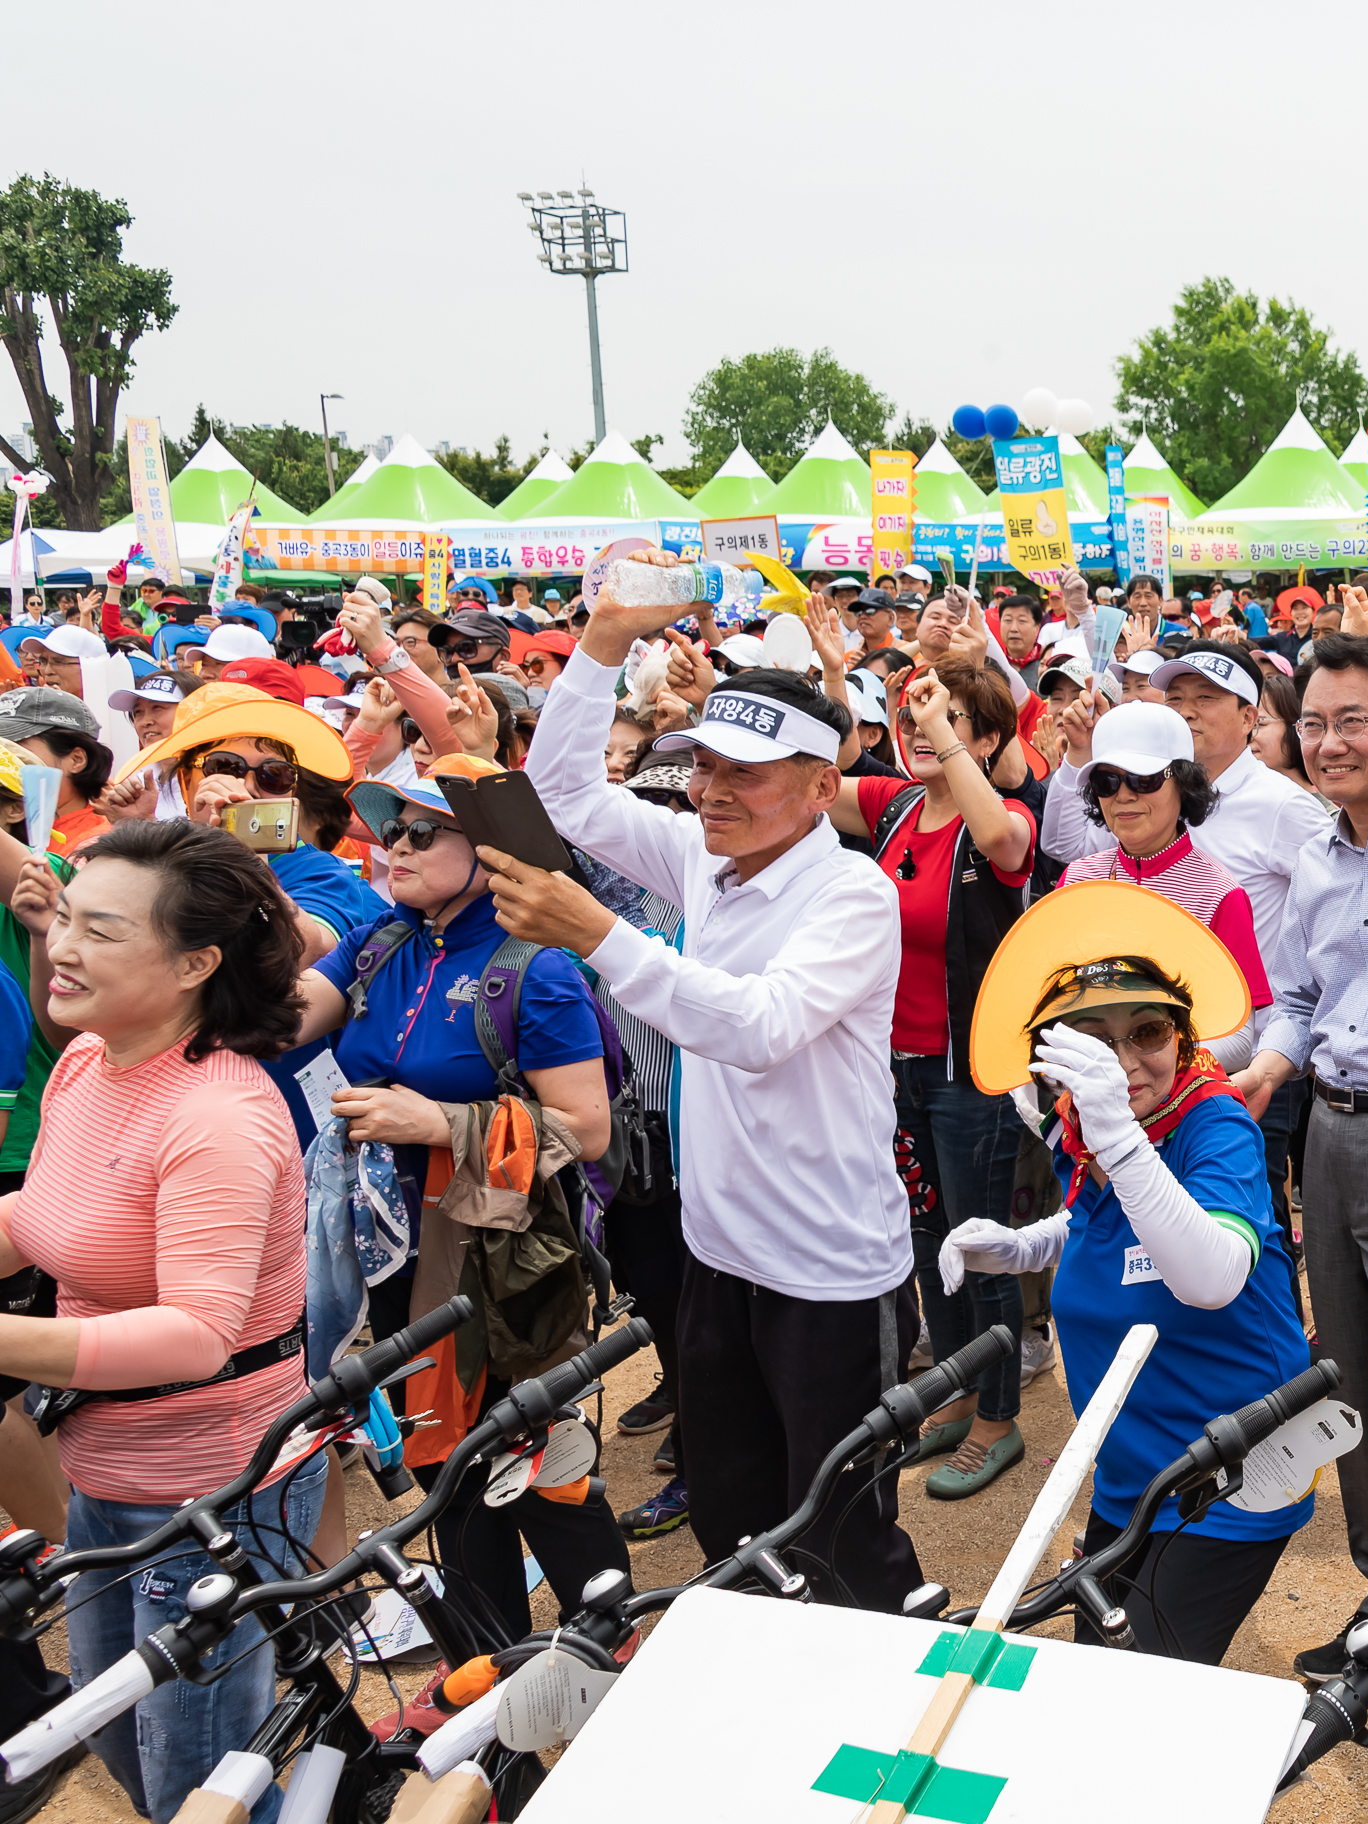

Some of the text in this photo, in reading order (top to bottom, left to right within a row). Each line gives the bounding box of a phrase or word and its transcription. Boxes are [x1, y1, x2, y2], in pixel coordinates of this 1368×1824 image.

[996, 452, 1059, 485] 일류광진
[1008, 518, 1034, 538] 일류
[321, 541, 370, 559] 중곡3동이
[713, 533, 769, 551] 구의제1동
[1017, 542, 1067, 561] 구의1동!
[1249, 543, 1275, 561] 함께
[1281, 542, 1321, 561] 만드는
[453, 545, 586, 569] 열혈중4 통합우승
[708, 696, 776, 733] 자양4동
